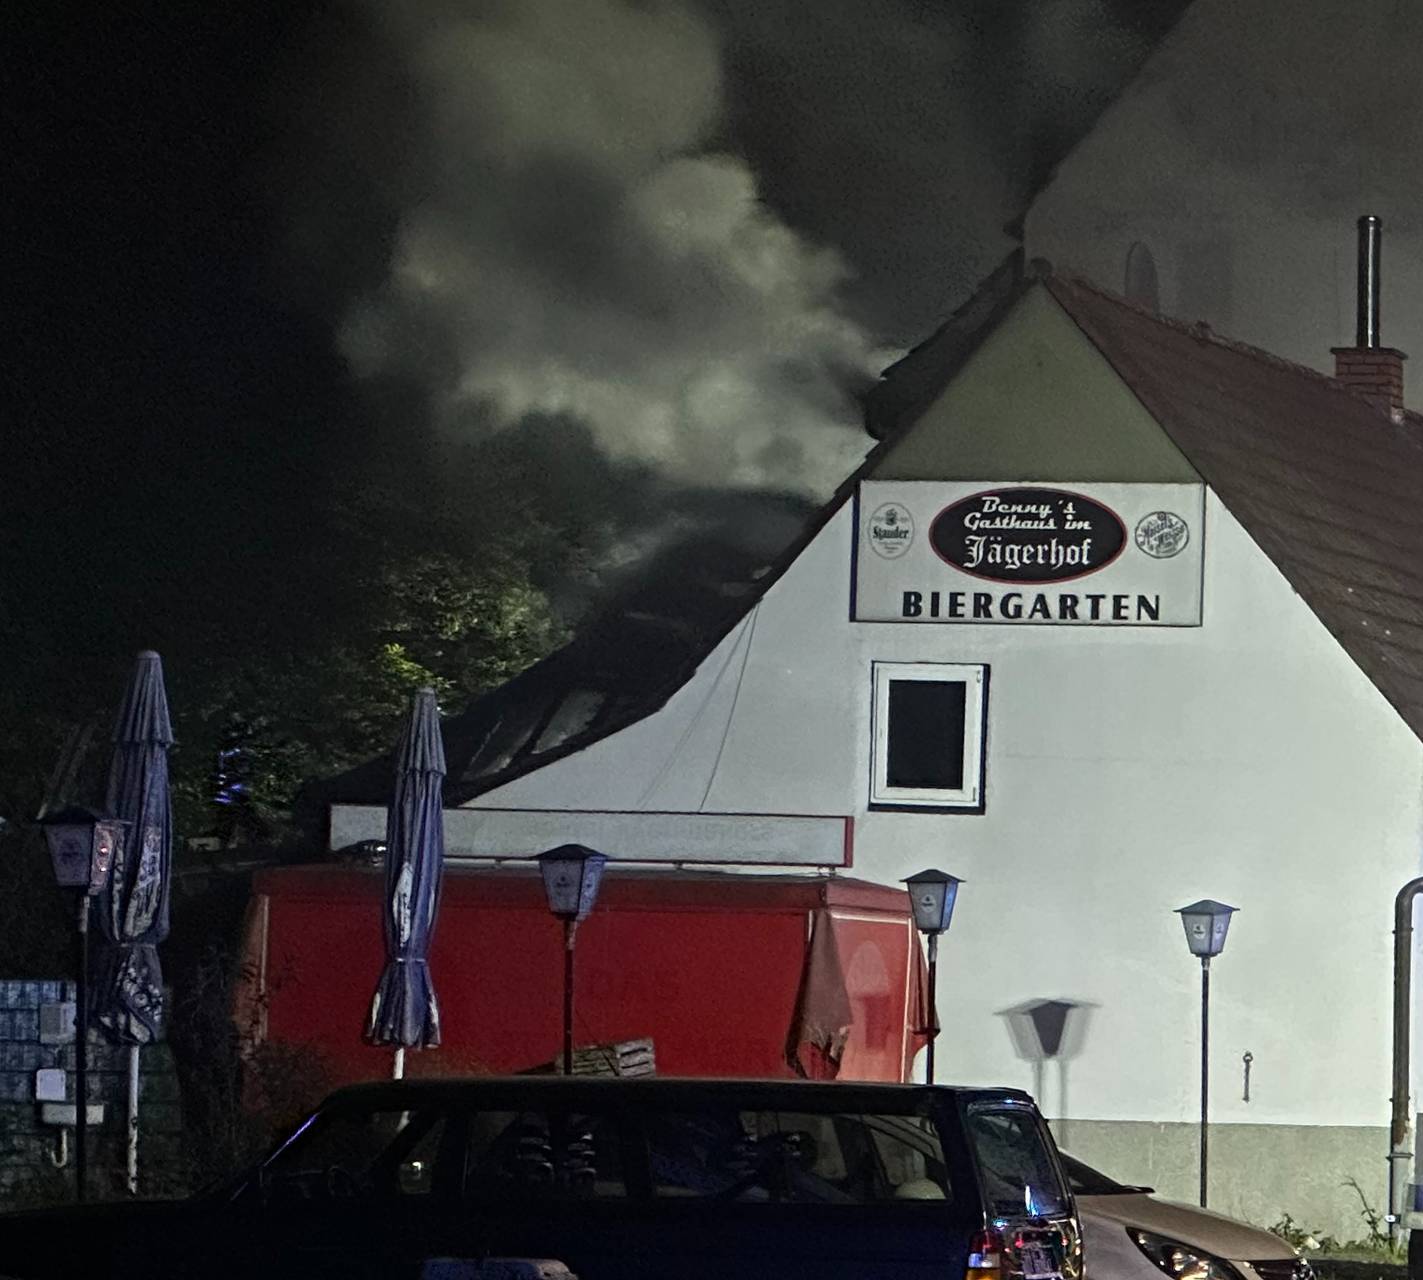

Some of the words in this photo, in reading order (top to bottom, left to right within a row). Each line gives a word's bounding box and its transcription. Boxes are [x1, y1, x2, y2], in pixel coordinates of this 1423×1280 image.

[964, 512, 1057, 531] Gasthaus
[1064, 514, 1092, 531] im
[963, 535, 1092, 570] Jägerhof
[902, 591, 1161, 622] BIERGARTEN
